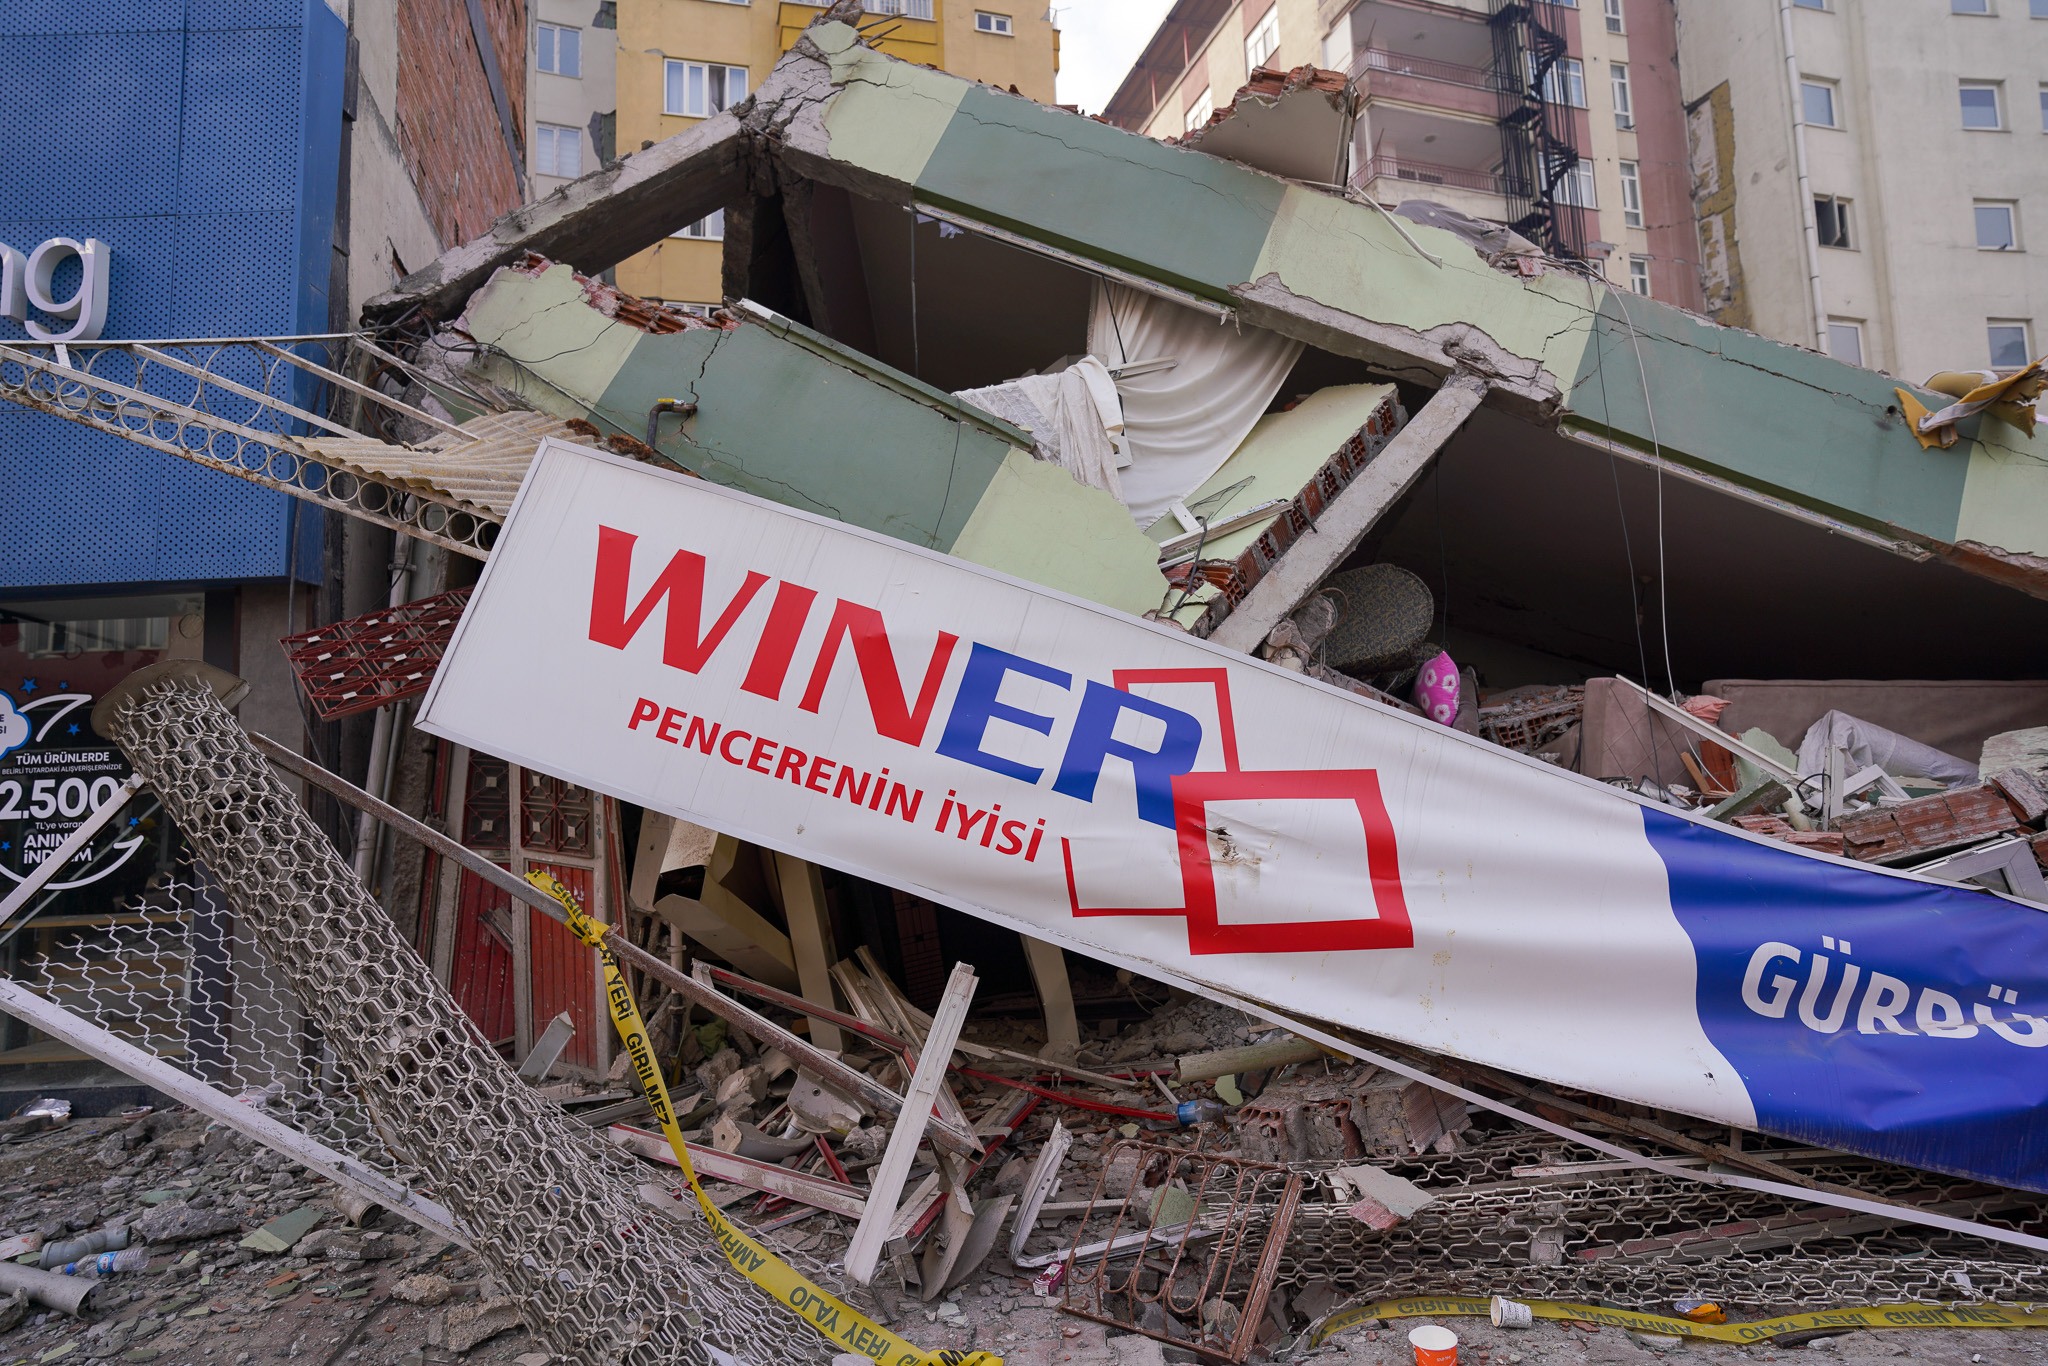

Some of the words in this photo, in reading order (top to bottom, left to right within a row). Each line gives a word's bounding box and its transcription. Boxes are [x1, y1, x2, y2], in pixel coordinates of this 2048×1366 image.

[588, 524, 1202, 830] WINER
[2, 767, 25, 775] BELİRLİ
[25, 766, 61, 774] TUTARDAKİ
[61, 763, 123, 773] ALIŞVERİŞLERİNİZDE
[16, 753, 42, 765] TÜM
[44, 751, 110, 764] ÜRÜNLERDE
[627, 697, 924, 822] PENCERENİN
[935, 788, 1046, 862] İYİSİ
[1741, 935, 2048, 1048] GÜRBÜ
